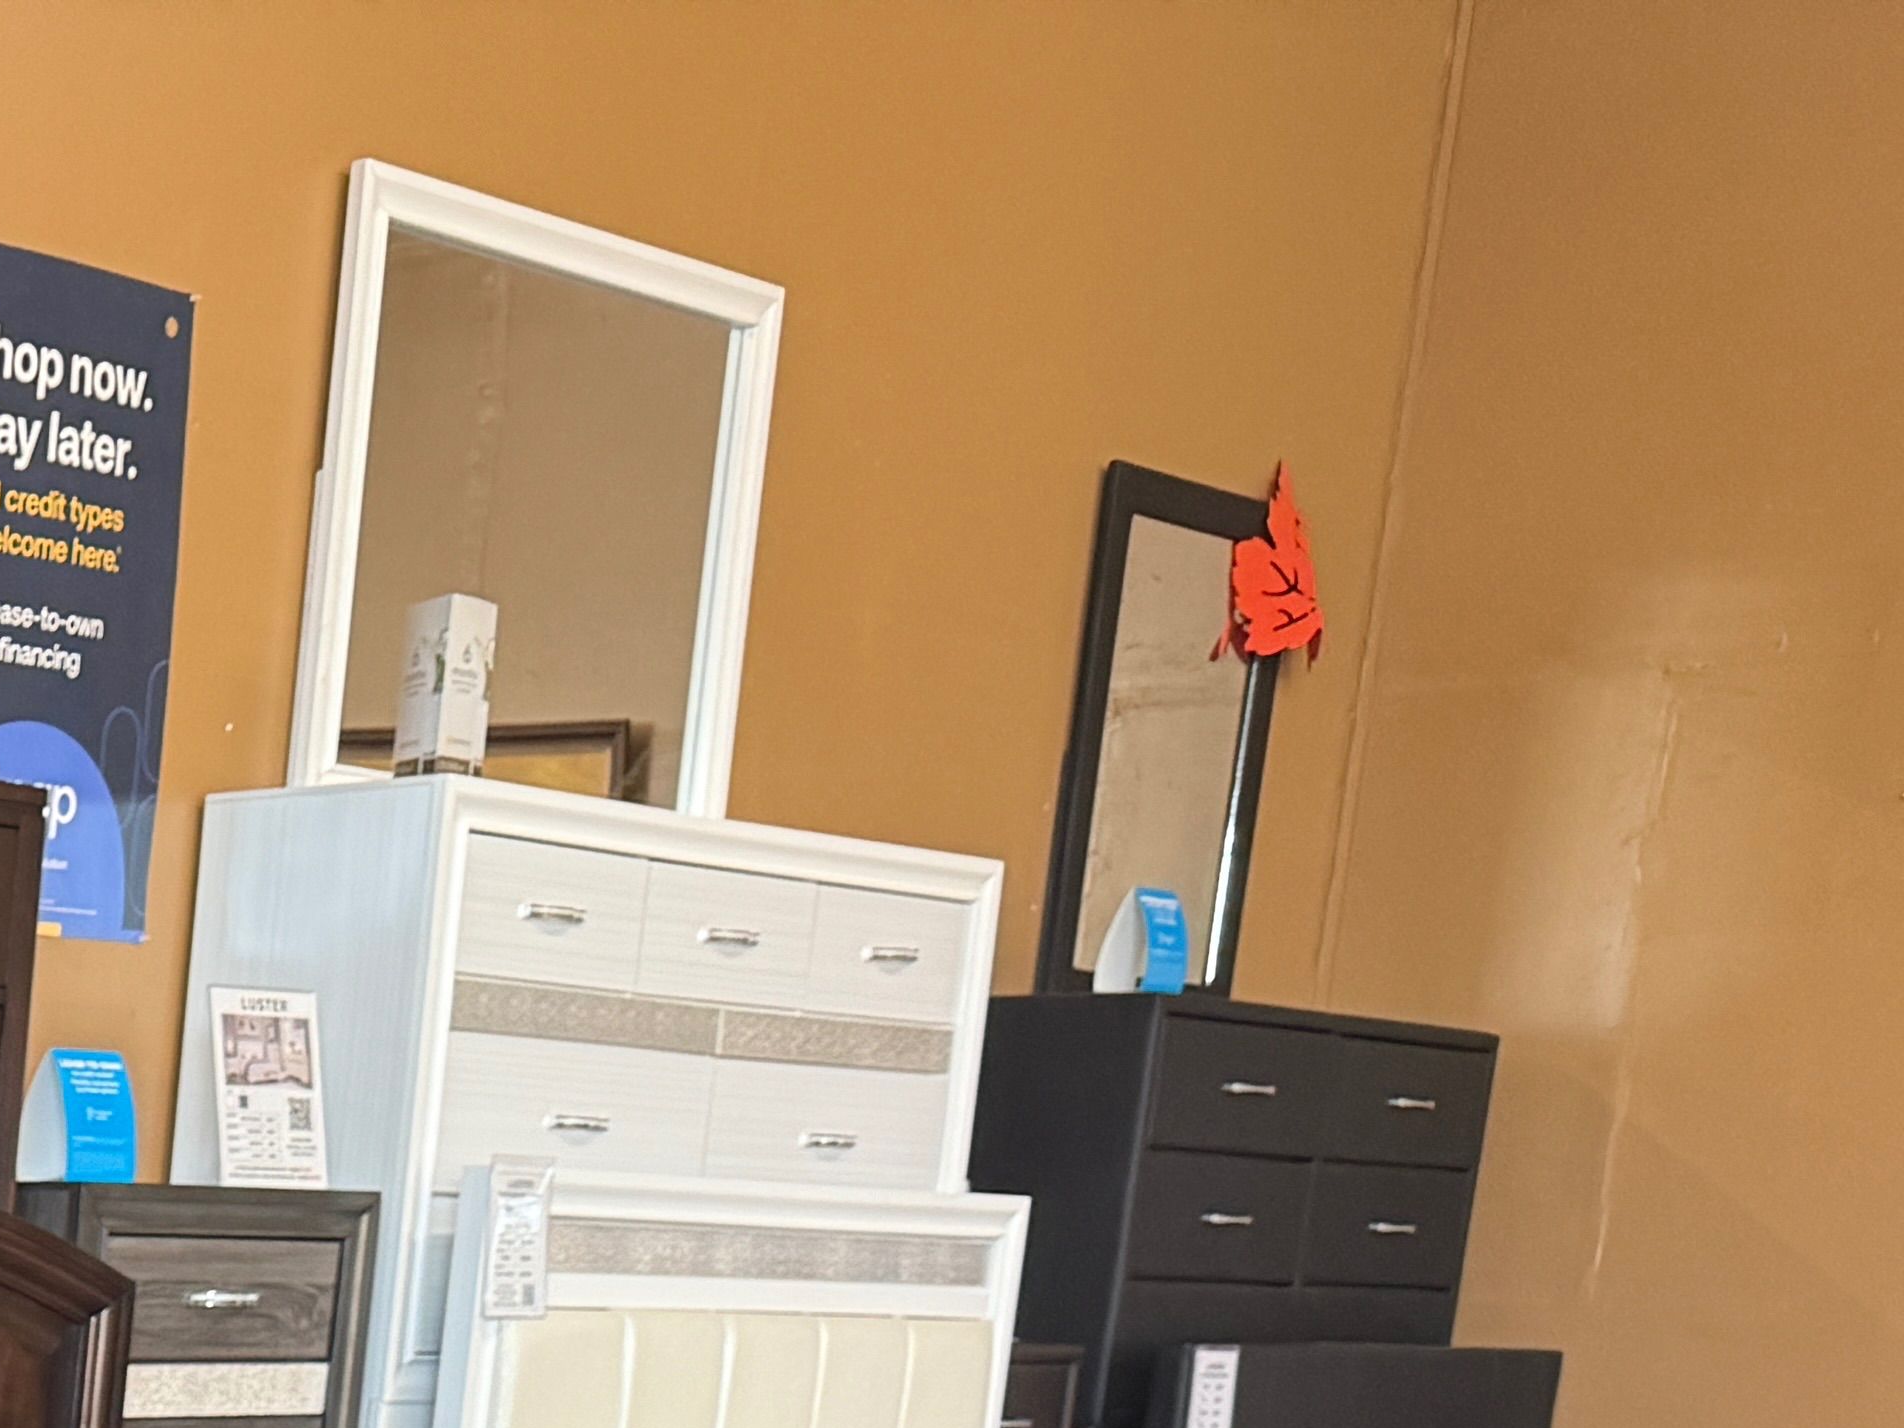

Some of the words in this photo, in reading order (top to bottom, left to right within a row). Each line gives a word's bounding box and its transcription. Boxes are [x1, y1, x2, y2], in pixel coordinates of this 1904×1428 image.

[70, 353, 153, 412] now.
[46, 410, 138, 480] later.
[4, 488, 66, 520] credit
[70, 496, 124, 534] types
